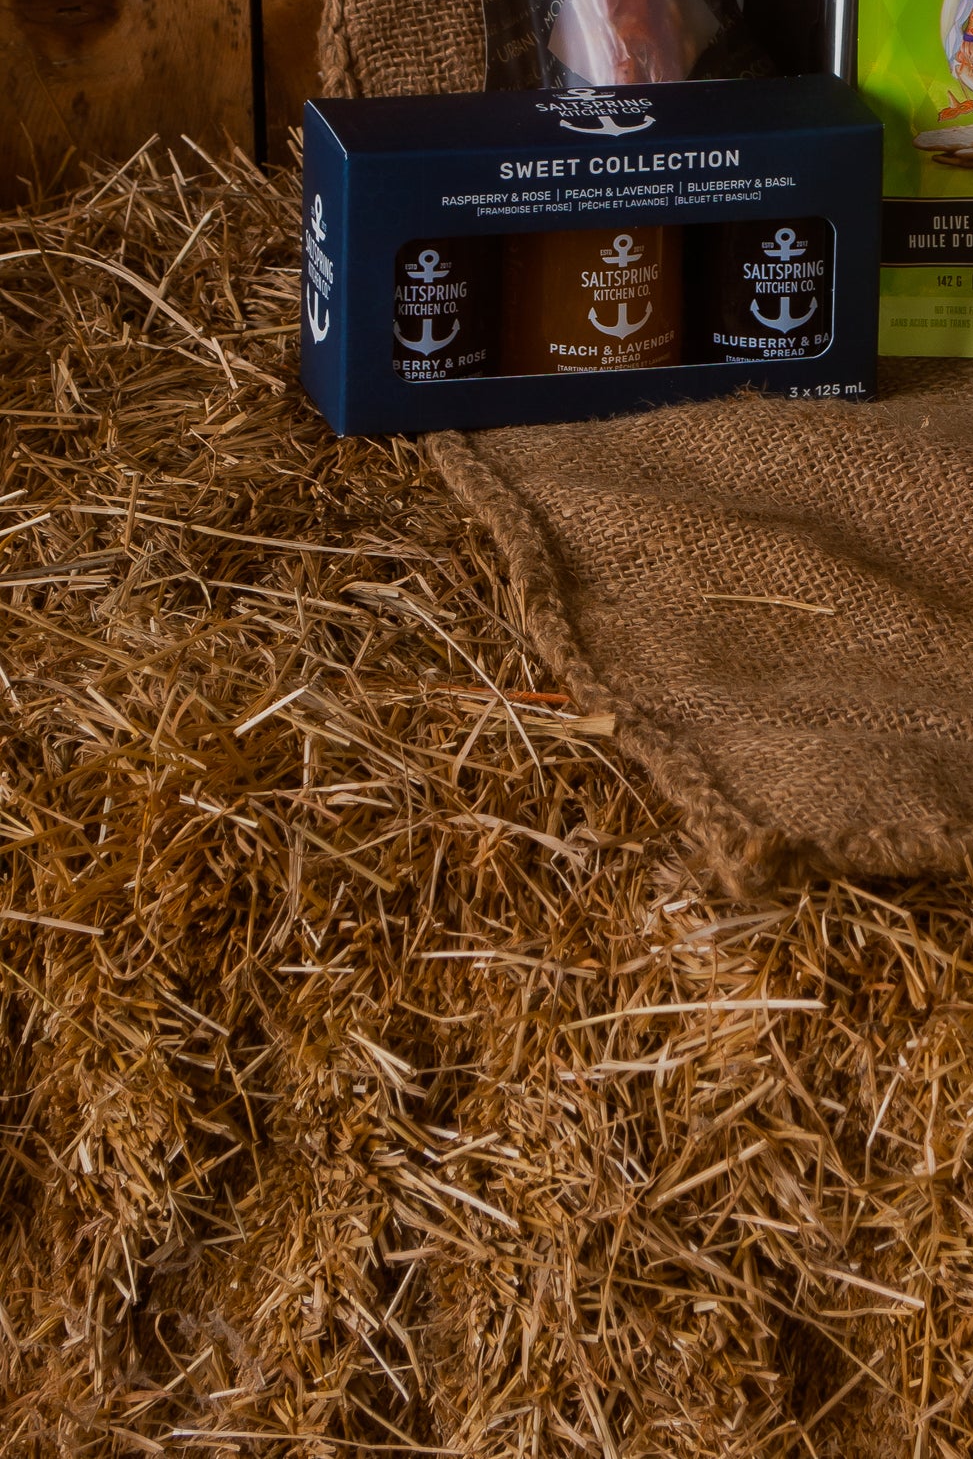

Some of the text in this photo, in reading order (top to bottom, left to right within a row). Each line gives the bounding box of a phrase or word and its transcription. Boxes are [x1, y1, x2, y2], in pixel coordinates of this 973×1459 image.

[535, 98, 653, 112] SALTSPRING
[559, 107, 619, 118] KITCHEN
[500, 149, 740, 180] SWEET COLLECTION
[565, 183, 674, 200] PEACH & LAVENDER
[688, 176, 796, 193] BLUEBERRY & BASIL
[442, 190, 551, 207] RASPBERRY & ROSE
[613, 200, 623, 209] ET
[625, 197, 669, 208] LAVANDE]
[674, 191, 761, 206] [BLEUET ET BASILIC]
[477, 202, 572, 217] [FRAMBOISE ET ROSE]
[933, 215, 971, 230] OLIVE
[908, 234, 946, 248] HUILE
[306, 229, 334, 285] SALTSPRING
[581, 263, 658, 288] SALTSPRING
[743, 260, 824, 280] SALTSPRING
[755, 279, 816, 294] KITCHEN CO.
[937, 276, 962, 287] 142 G
[594, 284, 651, 301] KITCHEN CO.
[398, 301, 459, 316] KITCHEN CO.
[946, 306, 967, 315] TRANS
[950, 318, 971, 328] TRANS
[549, 329, 675, 356] PEACH & LAVENDER
[713, 332, 810, 348] BLUEBERRY &
[445, 358, 454, 369] &
[458, 349, 487, 367] ROSE
[601, 353, 641, 365] SPREAD
[763, 348, 805, 358] SPREAD
[404, 370, 446, 380] SPREAD
[789, 381, 866, 398] 3 x 125 mL
